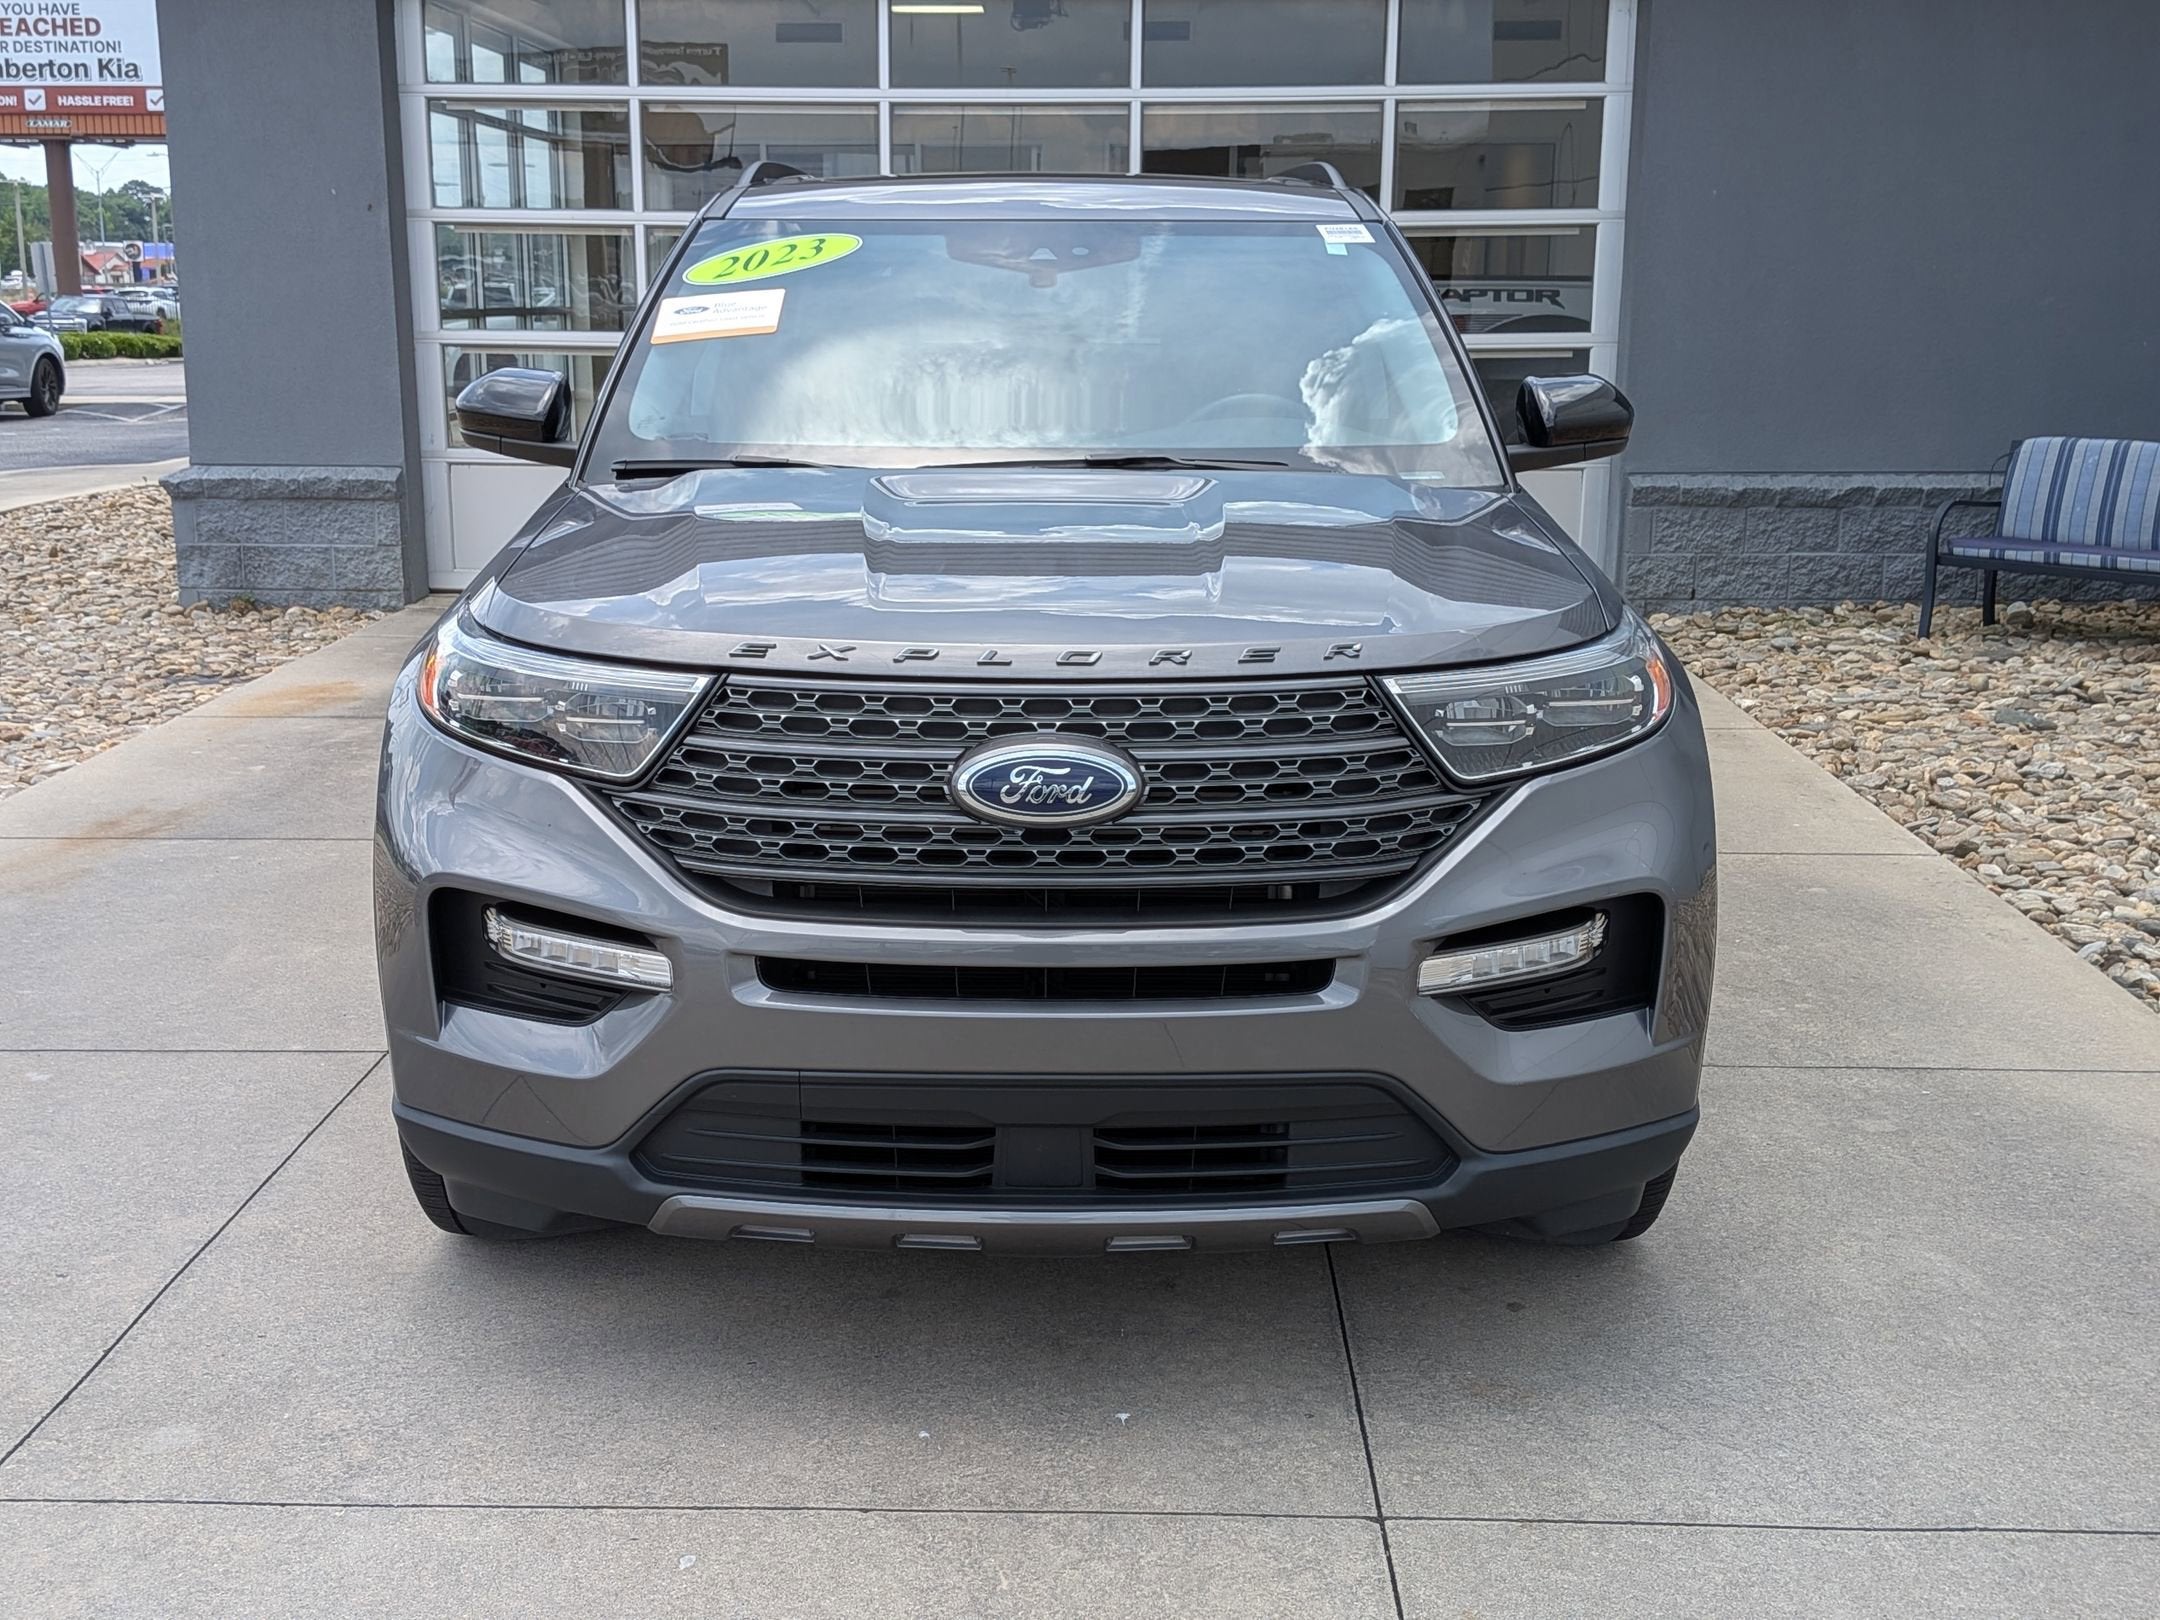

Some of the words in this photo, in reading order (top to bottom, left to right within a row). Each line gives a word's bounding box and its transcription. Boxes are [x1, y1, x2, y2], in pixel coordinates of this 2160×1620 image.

[1, 3, 34, 16] YOU
[38, 3, 80, 16] HAVE
[0, 17, 102, 37] EACHED
[13, 40, 122, 54] DESTINATION!
[0, 57, 90, 80] berton
[98, 57, 142, 80] Kia
[57, 95, 102, 107] HASSLE
[103, 95, 134, 107] FREE!
[29, 119, 69, 128] LAMAR
[712, 237, 827, 280] 2023
[1437, 287, 1566, 311] APTOR
[728, 641, 1364, 667] EXPLORER
[1000, 765, 1094, 804] Ford
